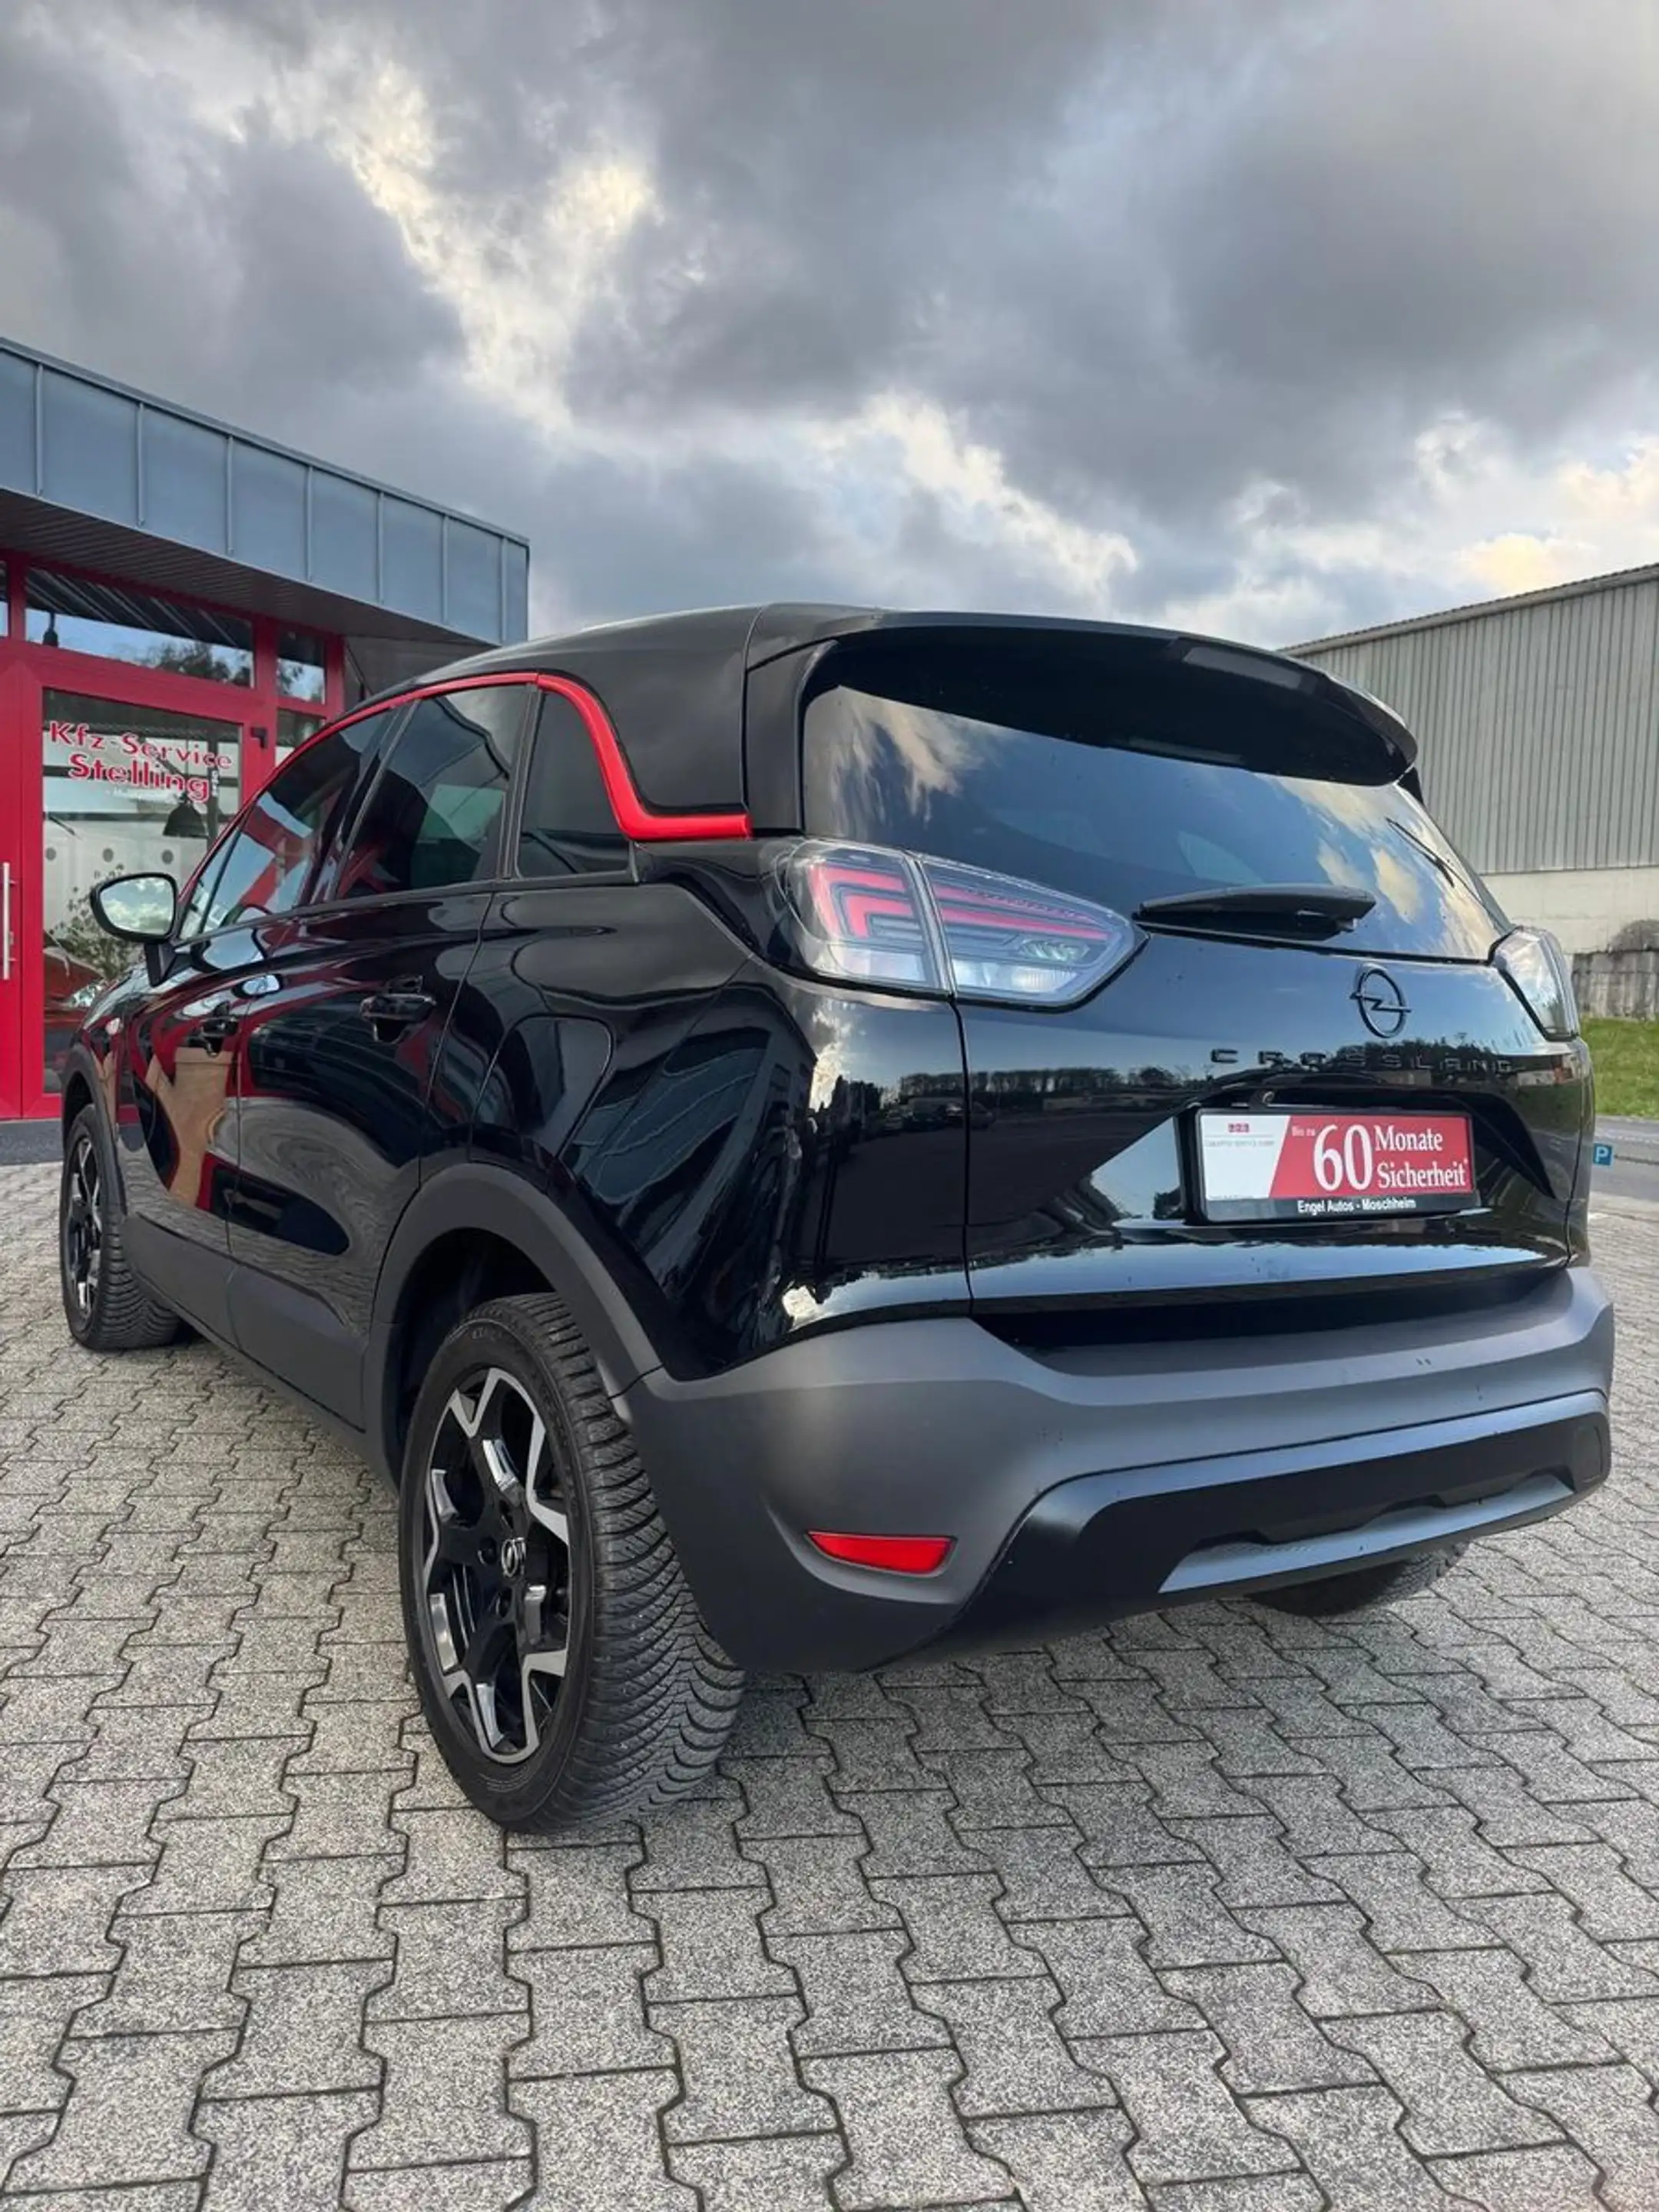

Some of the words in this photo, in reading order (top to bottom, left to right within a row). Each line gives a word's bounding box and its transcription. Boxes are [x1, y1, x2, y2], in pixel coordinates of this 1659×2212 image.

[68, 753, 210, 803] Stelling
[1313, 1124, 1373, 1191] 60
[1373, 1124, 1444, 1152] Monate
[1595, 1146, 1609, 1163] P
[1297, 1200, 1326, 1216] Engel
[1327, 1199, 1354, 1214] Autos
[1361, 1197, 1416, 1212] Moschheim
